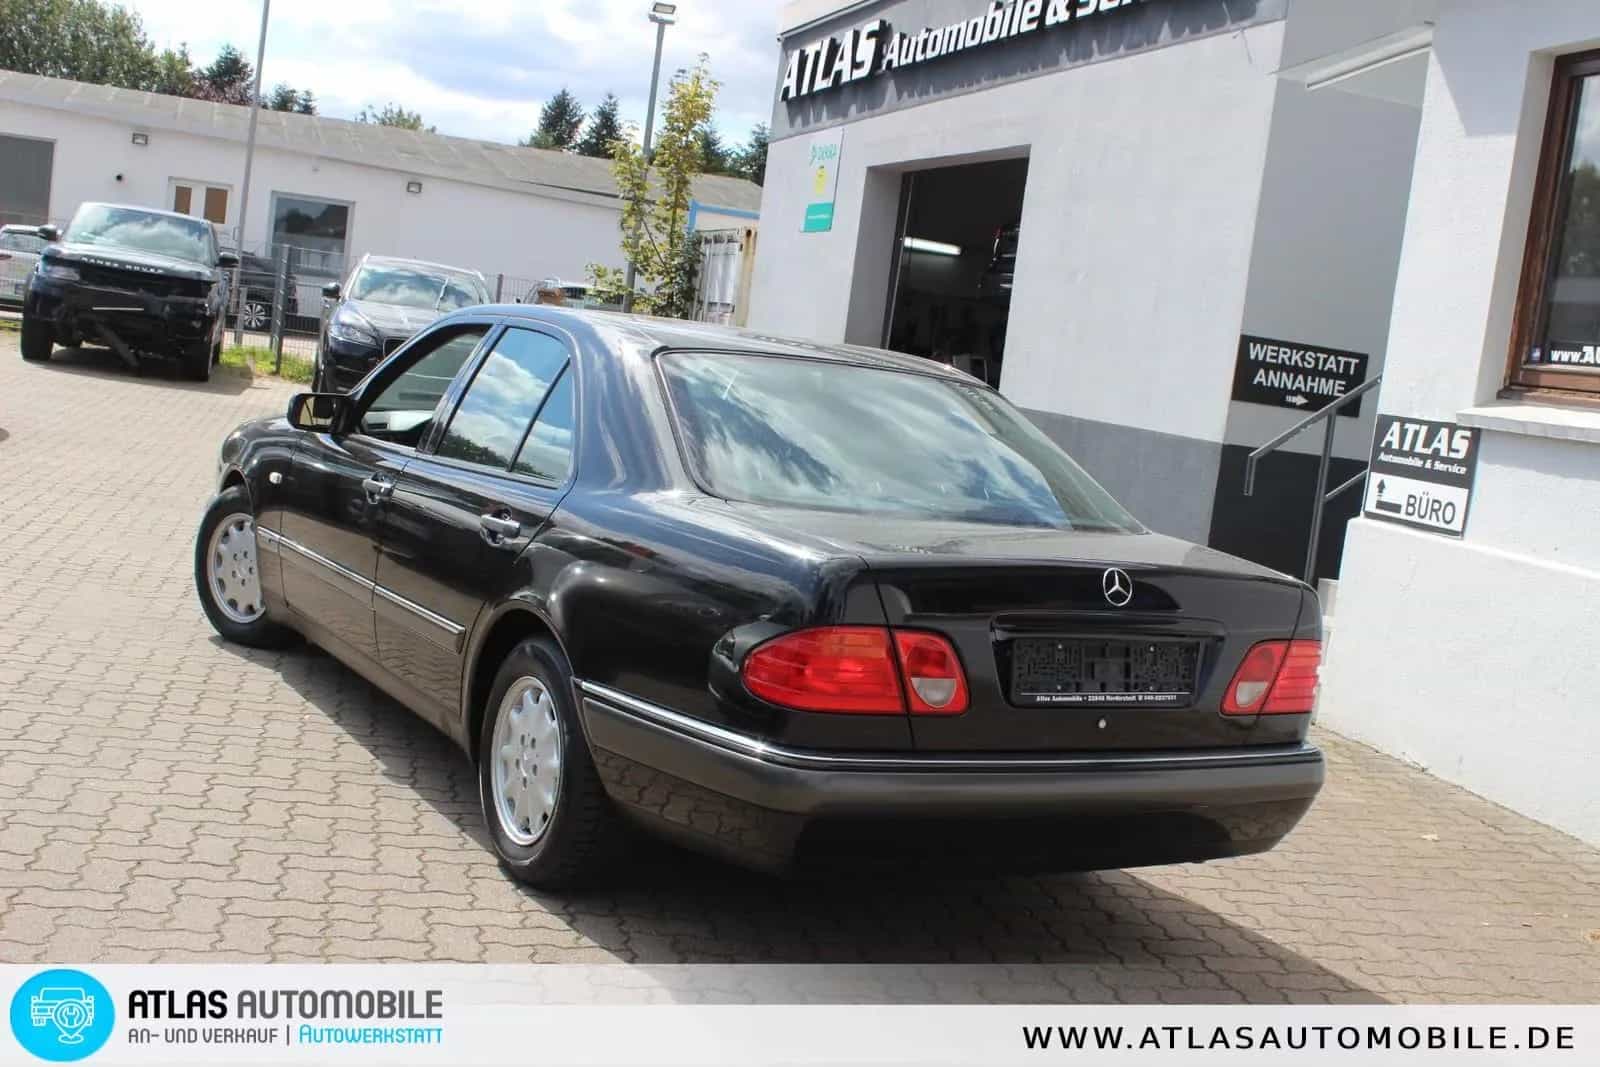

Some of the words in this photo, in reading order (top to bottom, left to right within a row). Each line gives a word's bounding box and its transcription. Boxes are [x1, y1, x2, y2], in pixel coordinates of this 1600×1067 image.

[779, 19, 881, 101] ATLAS
[881, 0, 1039, 71] Automobile
[1249, 342, 1359, 375] WERKSTATT
[1253, 368, 1346, 397] ANNAHME
[1380, 421, 1472, 460] ATLAS
[1433, 460, 1467, 475] Service
[1405, 491, 1456, 525] BÜRO
